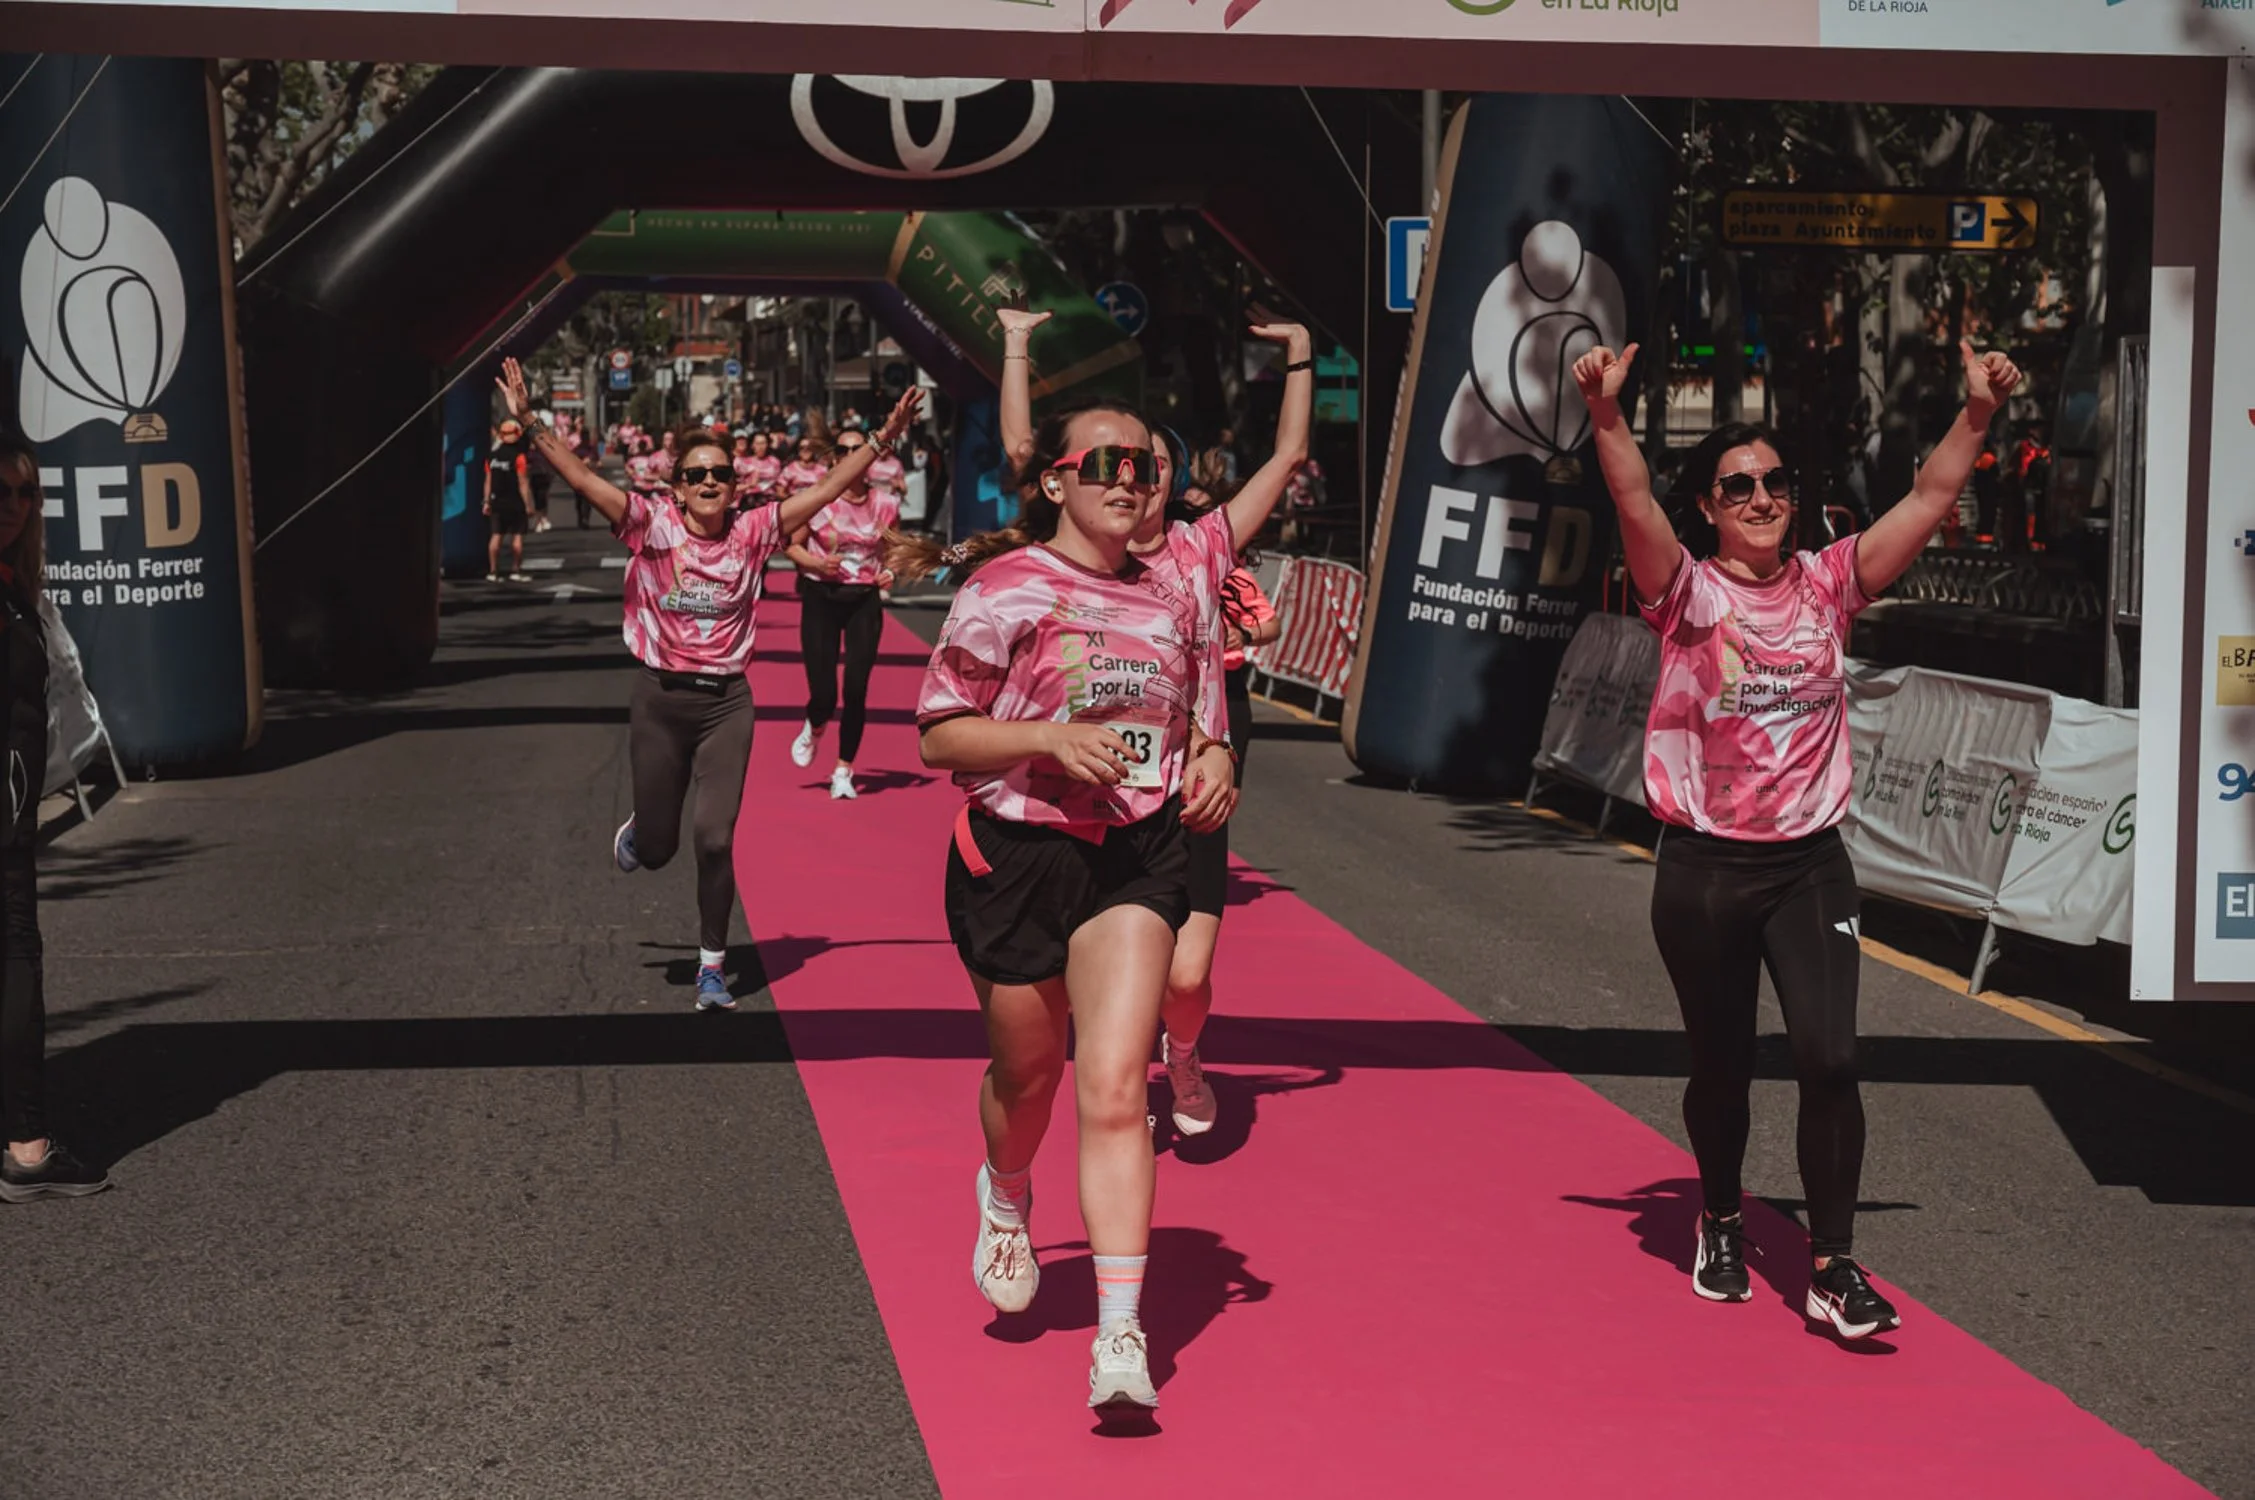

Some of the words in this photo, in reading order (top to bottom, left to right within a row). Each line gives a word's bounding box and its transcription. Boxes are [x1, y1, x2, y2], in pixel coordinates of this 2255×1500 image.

[1848, 0, 1866, 12] DE
[1869, 1, 1887, 13] LA
[1890, 1, 1929, 13] RIOJA
[1729, 221, 1782, 240] plaza
[1795, 222, 1937, 241] Ayuntamiento
[1952, 204, 1980, 239] P
[1418, 484, 1592, 587] FFD
[44, 559, 131, 580] ndación
[138, 557, 204, 579] Ferrer
[82, 585, 103, 606] el
[115, 579, 205, 607] Deporte
[1412, 574, 1519, 612] Fundación
[1525, 593, 1579, 616] Ferrer
[1408, 600, 1456, 627] para
[1466, 611, 1488, 631] el
[1498, 614, 1574, 641] Deporte
[1085, 631, 1105, 648] XI
[1089, 654, 1159, 675] Carrera
[1743, 659, 1804, 676] Carrera
[1091, 681, 1122, 699] por
[1125, 678, 1140, 697] la
[1740, 683, 1770, 698] por
[1773, 680, 1788, 695] la
[2024, 823, 2050, 844] Rioja
